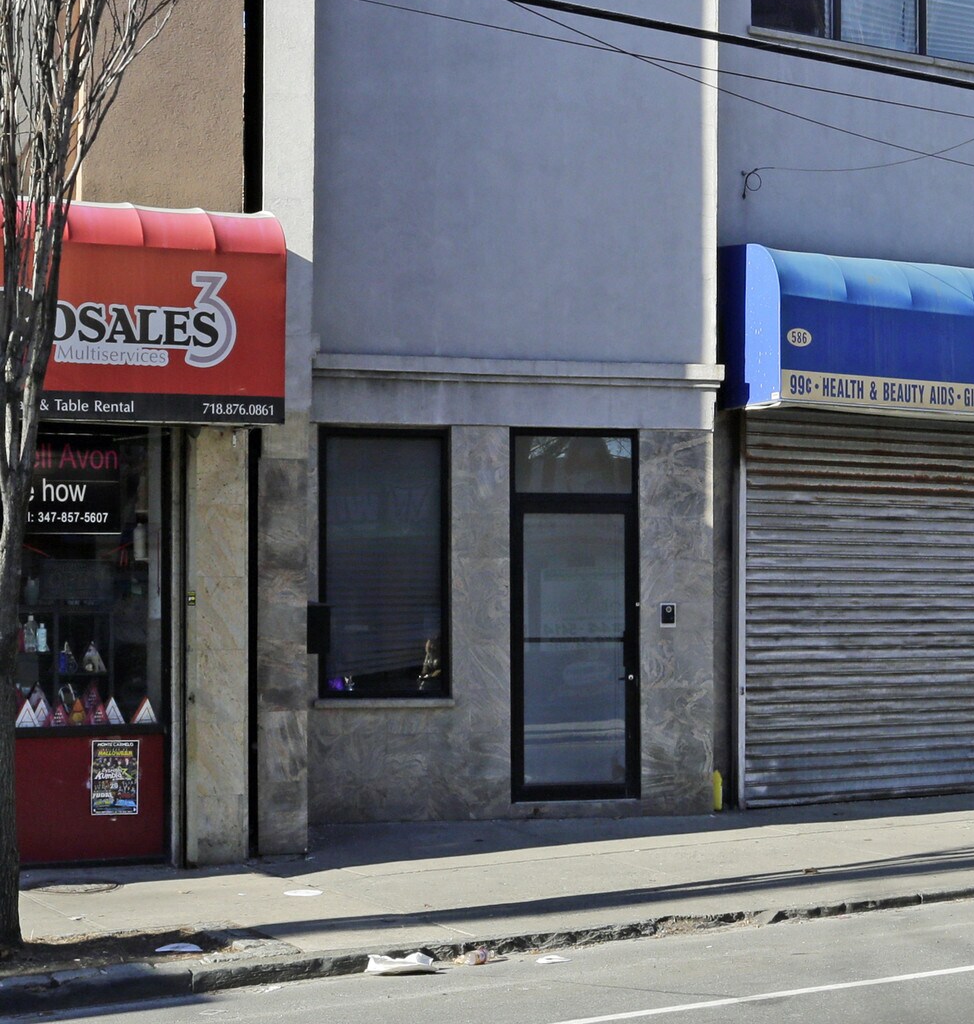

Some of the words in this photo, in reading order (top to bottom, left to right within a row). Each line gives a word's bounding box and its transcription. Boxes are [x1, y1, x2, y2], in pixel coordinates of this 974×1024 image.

[52, 304, 219, 348] OSALES
[791, 331, 807, 344] 586
[57, 344, 167, 364] Multiservices
[790, 374, 812, 395] 99¢
[822, 377, 864, 400] HEALTH
[869, 381, 878, 401] &
[883, 382, 925, 404] BEAUTY
[929, 385, 955, 406] AIDS
[40, 398, 49, 411] &
[54, 399, 89, 412] Table
[94, 400, 134, 413] Rental
[202, 403, 275, 416] 718.876.0861
[59, 443, 118, 469] Avon
[42, 478, 87, 502] how
[38, 511, 109, 523] 347-857-5607
